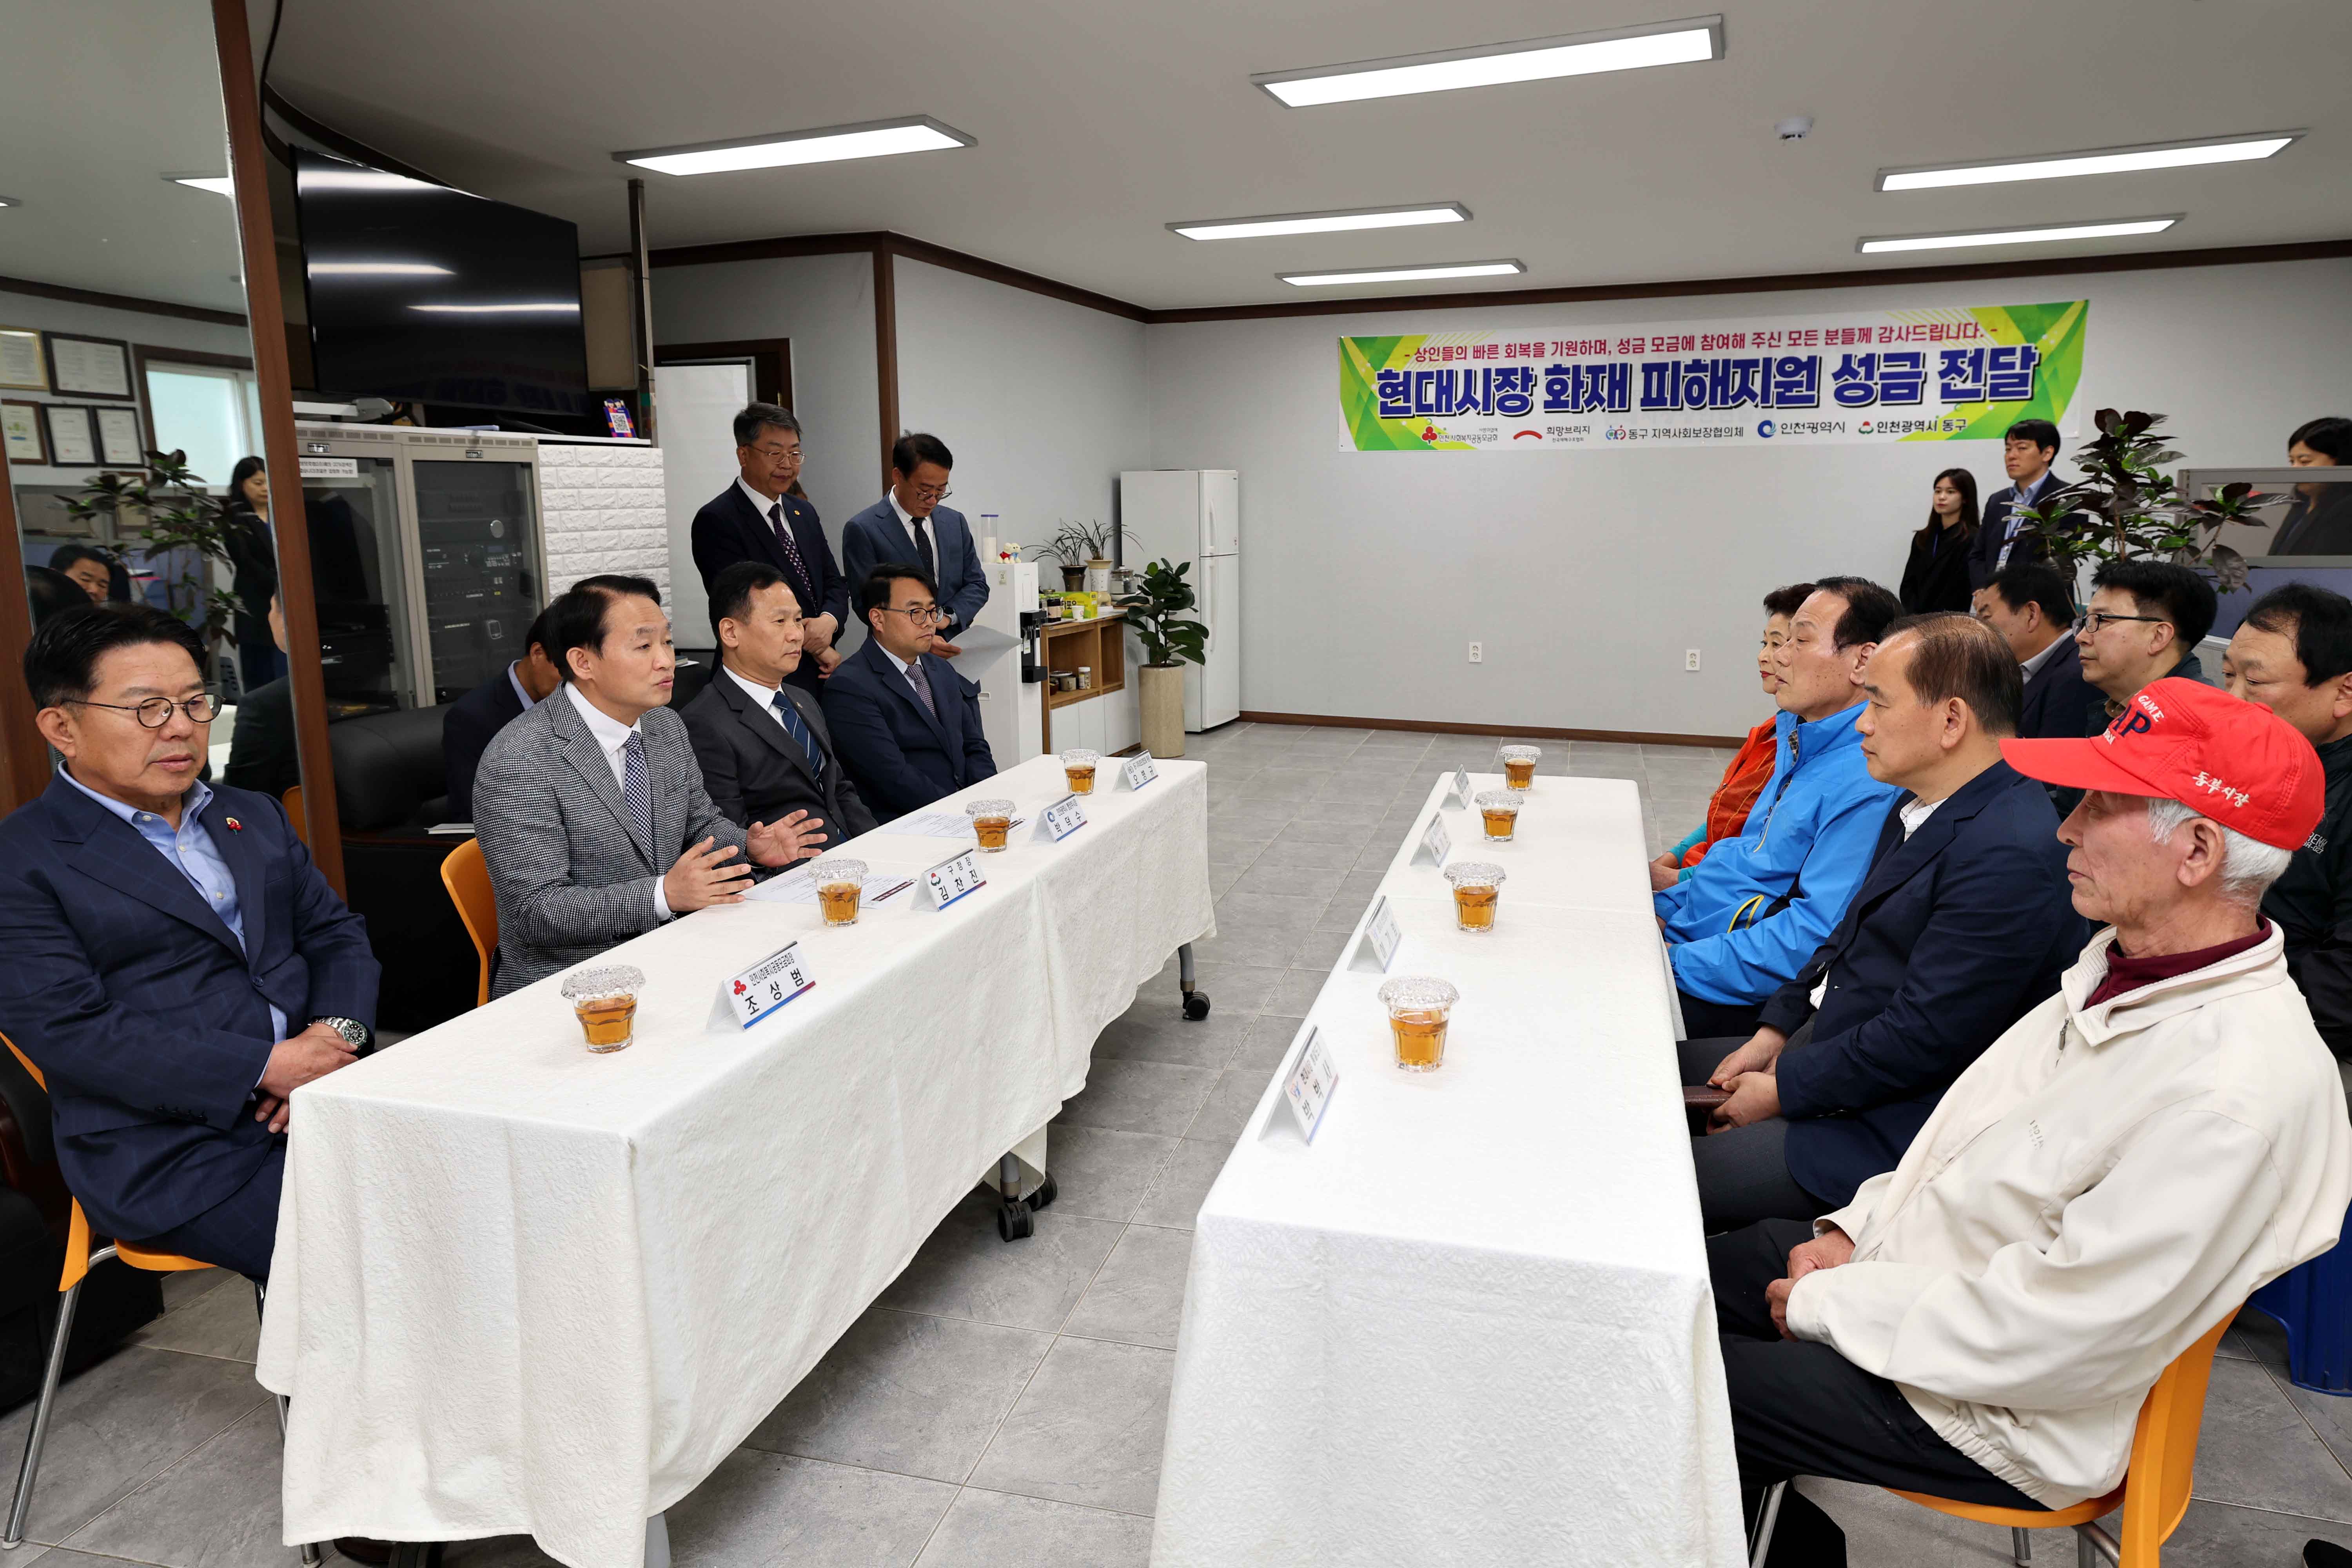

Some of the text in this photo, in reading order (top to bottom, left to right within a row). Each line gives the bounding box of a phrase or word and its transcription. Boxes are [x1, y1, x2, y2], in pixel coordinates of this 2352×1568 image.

[1415, 322, 1984, 362] 상인들의 빠른 회복을 기원하며, 성금 모금에 참여해 주신 모든 분들께 감사드립니다.
[1377, 344, 2041, 417] 현대시장 화재 피해지원 성금 전달
[1546, 426, 1590, 436] 희망브리지
[1629, 426, 1744, 439] 동구 지역사회보장협의체
[1781, 421, 1845, 434] 인천광역시
[1877, 419, 1967, 434] 인천광역시 동구
[2138, 695, 2165, 722] GAME
[2192, 771, 2250, 808] 동부시장
